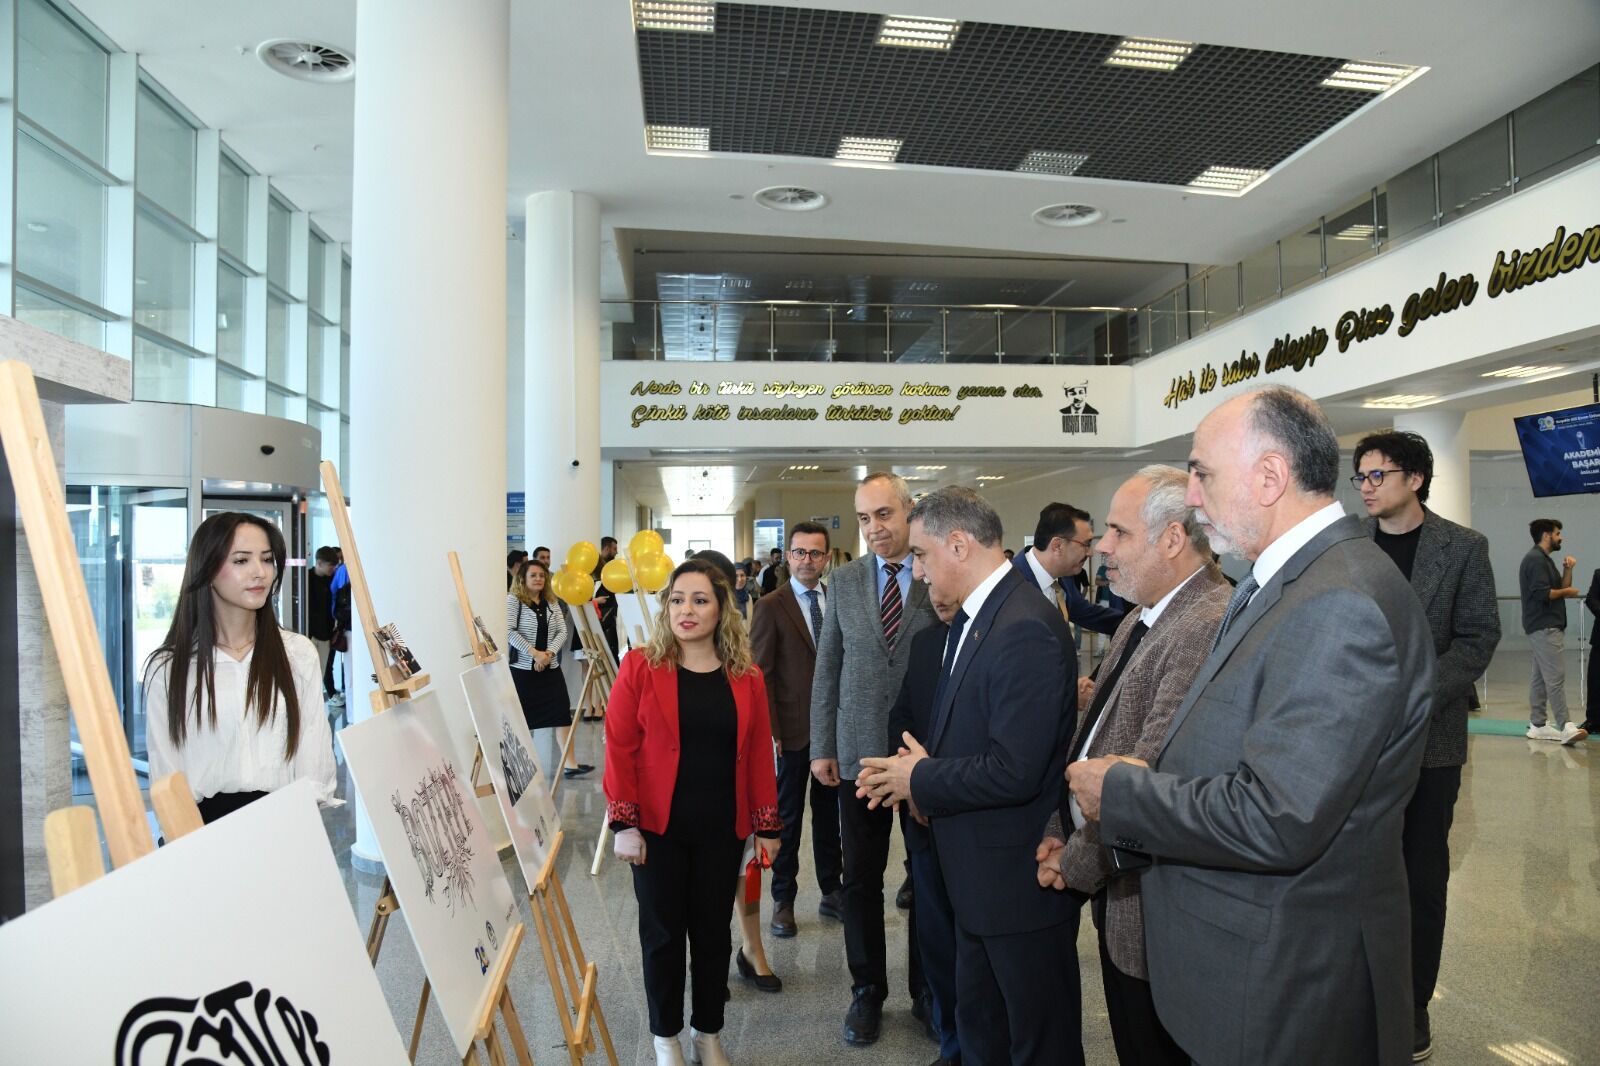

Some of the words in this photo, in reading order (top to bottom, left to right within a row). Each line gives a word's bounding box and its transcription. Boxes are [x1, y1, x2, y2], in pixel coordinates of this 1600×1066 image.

[1199, 362, 1218, 395] ile
[1398, 272, 1479, 337] gelen
[689, 381, 710, 395] bir
[717, 381, 756, 395] türkü
[763, 381, 825, 399] söyleyen
[831, 381, 894, 399] görürsen
[900, 382, 952, 396] korkma
[631, 404, 688, 428] Çünkü
[692, 403, 731, 420] kötü
[825, 404, 894, 421] türküleri
[898, 404, 961, 425] yoktur!
